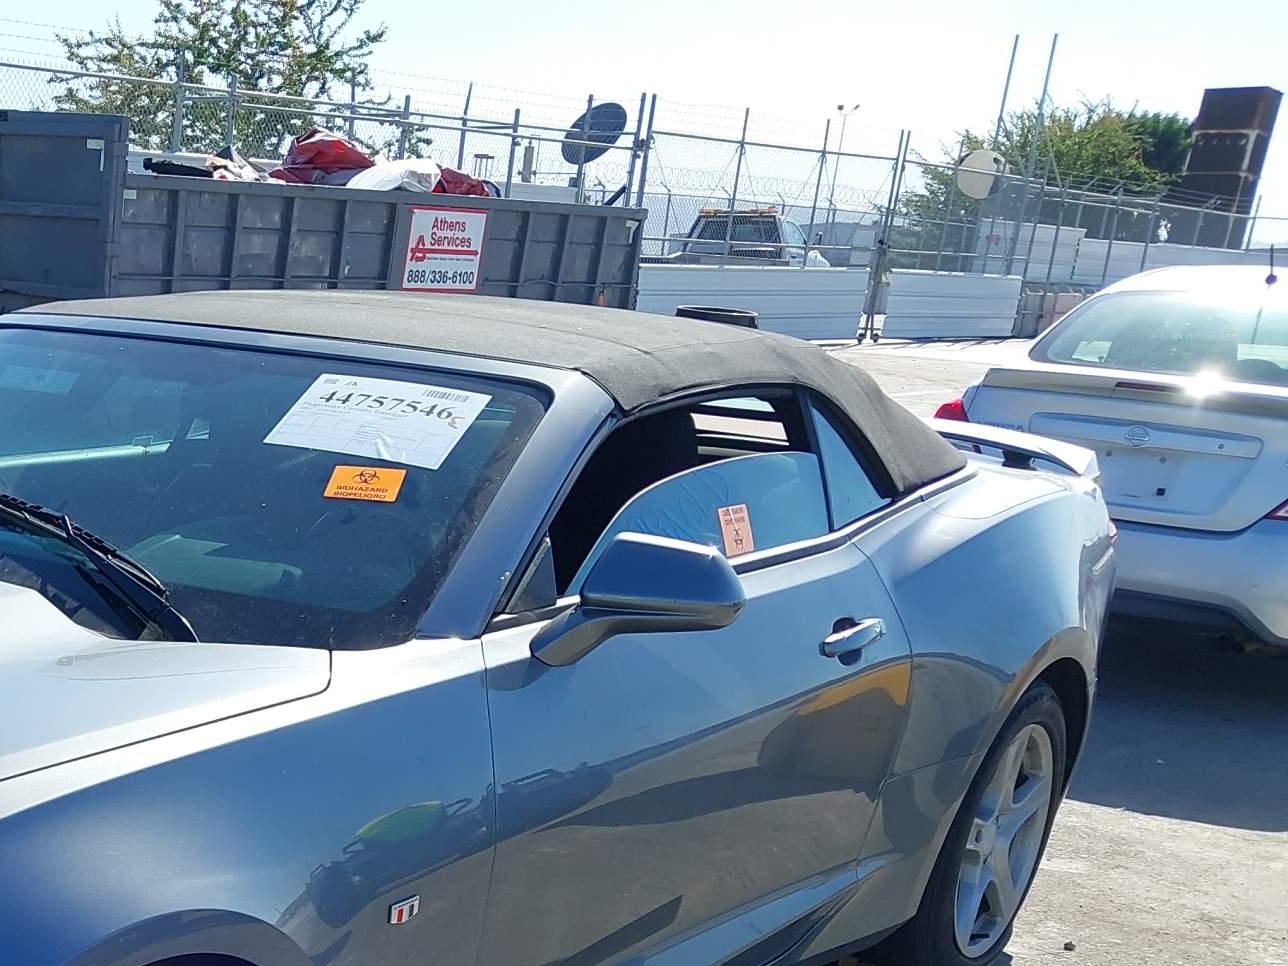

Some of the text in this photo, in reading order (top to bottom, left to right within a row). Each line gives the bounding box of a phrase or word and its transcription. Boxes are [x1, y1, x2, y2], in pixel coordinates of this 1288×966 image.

[431, 216, 466, 232] Athens
[429, 232, 472, 248] Services
[407, 269, 474, 284] 888/336-6100
[319, 390, 457, 420] 44757546
[336, 485, 388, 493] BIOHAZARD
